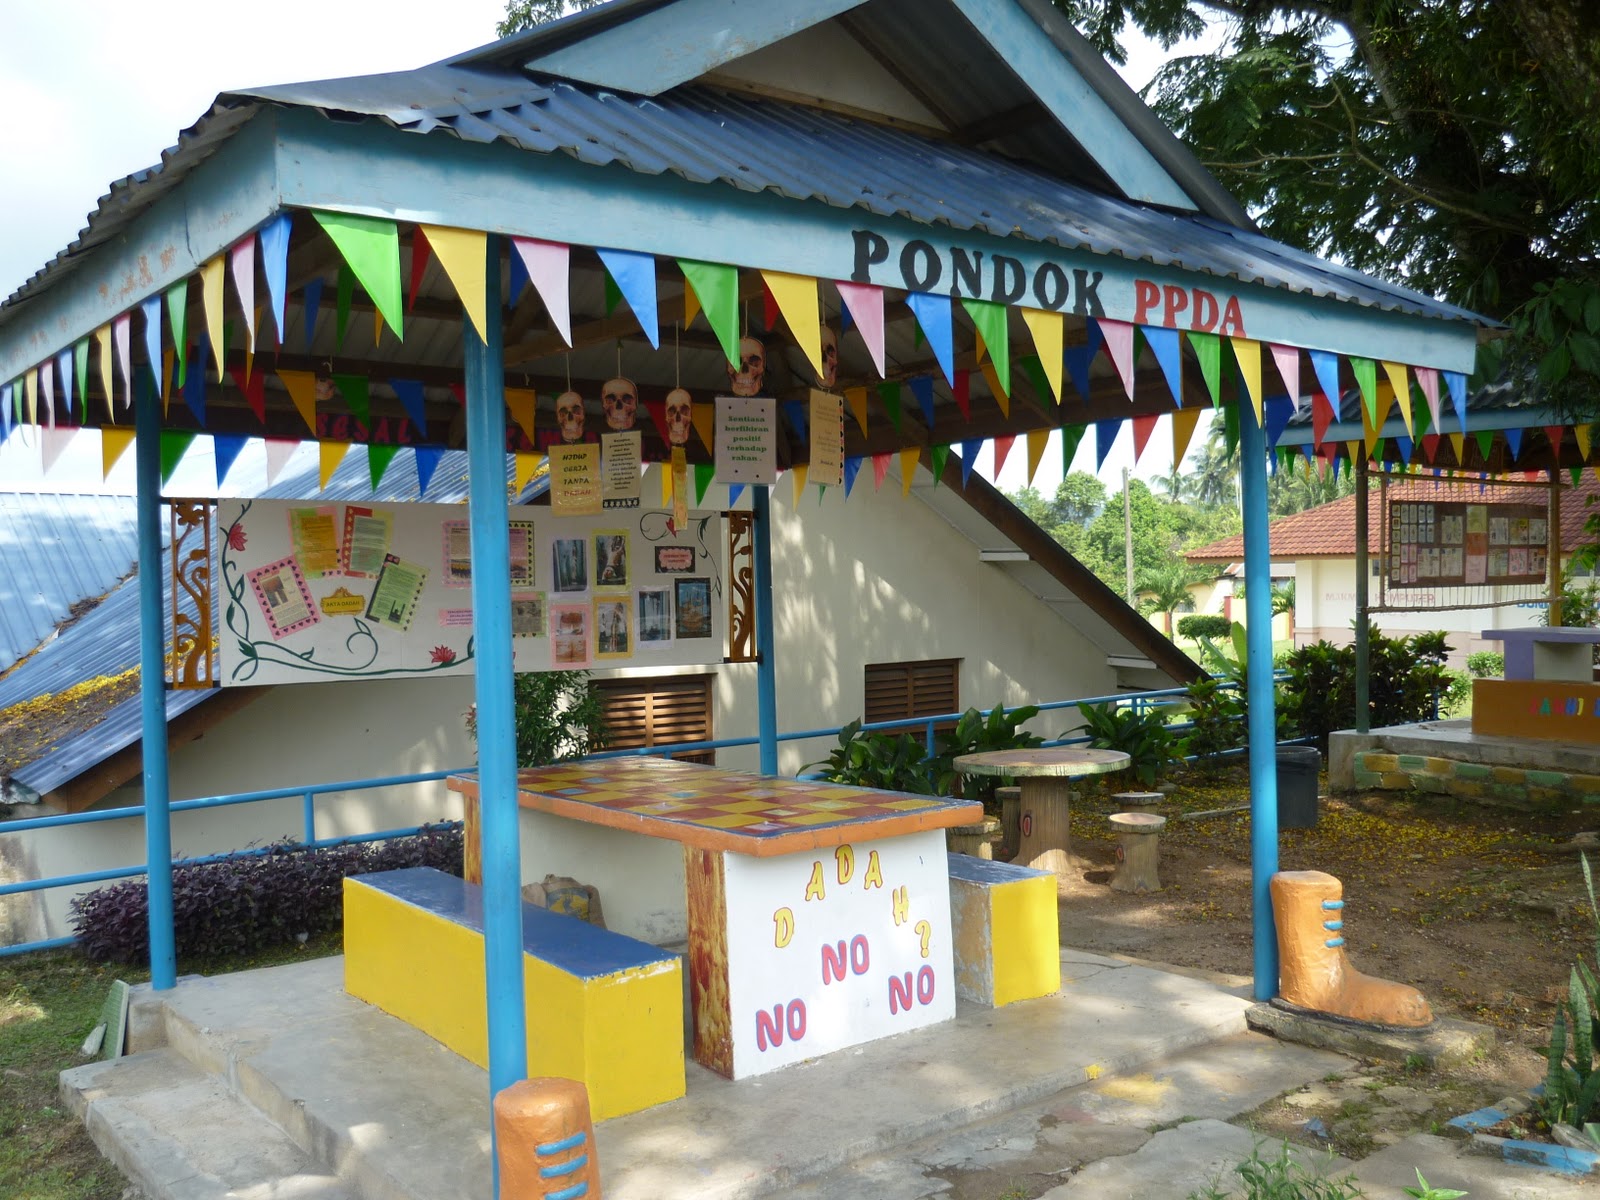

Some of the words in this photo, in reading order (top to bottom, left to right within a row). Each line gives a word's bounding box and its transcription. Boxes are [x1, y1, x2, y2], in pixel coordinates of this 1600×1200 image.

[851, 229, 1105, 317] PONDOK
[1134, 279, 1246, 338] PPDA
[727, 445, 767, 453] terhadap
[564, 477, 589, 485] TANPA
[821, 934, 870, 985] NO
[888, 964, 935, 1015] NO
[756, 998, 807, 1052] NO
